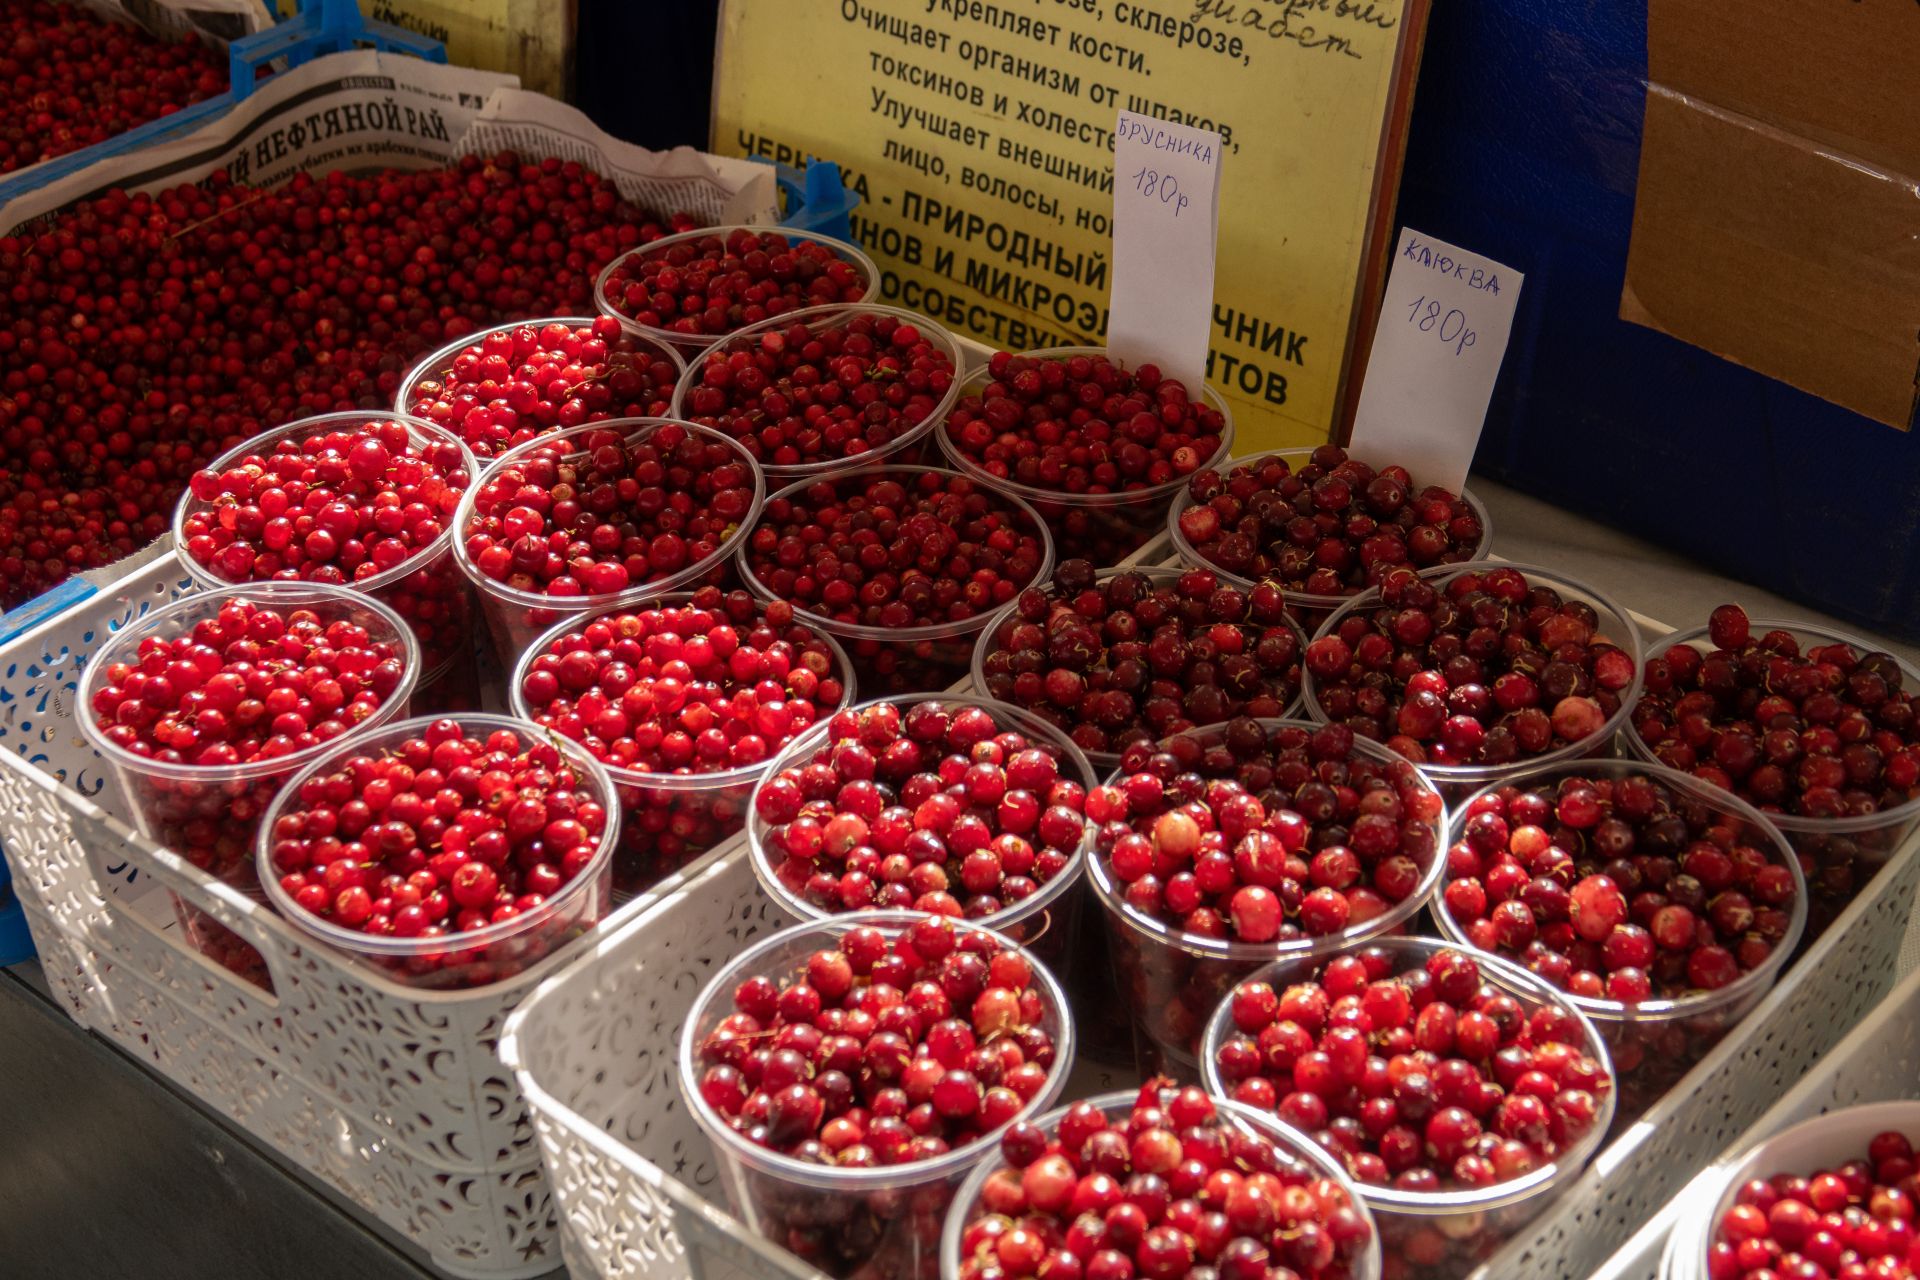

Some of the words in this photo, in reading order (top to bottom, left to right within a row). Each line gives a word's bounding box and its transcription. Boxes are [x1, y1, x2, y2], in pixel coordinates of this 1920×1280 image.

[840, 0, 951, 53] Очищает
[958, 41, 1080, 97] организм
[1089, 83, 1119, 108] от
[1068, 31, 1152, 76] кости.
[1114, 2, 1251, 66] склерозе,
[870, 51, 984, 107] токсинов
[993, 93, 1008, 116] и
[255, 97, 402, 169] НЕФТЯНОЙ
[404, 104, 451, 143] РАЙ
[870, 86, 990, 151] Улучшает
[997, 137, 1114, 195] внешний
[1119, 117, 1211, 165] БРУСНИКА
[882, 140, 951, 185] лицо,
[961, 166, 1066, 226] волосы,
[1132, 167, 1188, 217] 180р
[902, 190, 1107, 291] ПРИРОДНЫЙ
[1213, 303, 1308, 366] ЧНИК
[934, 247, 956, 278] И
[1403, 238, 1501, 296] КЛЮКВА
[1406, 296, 1476, 356] 180р
